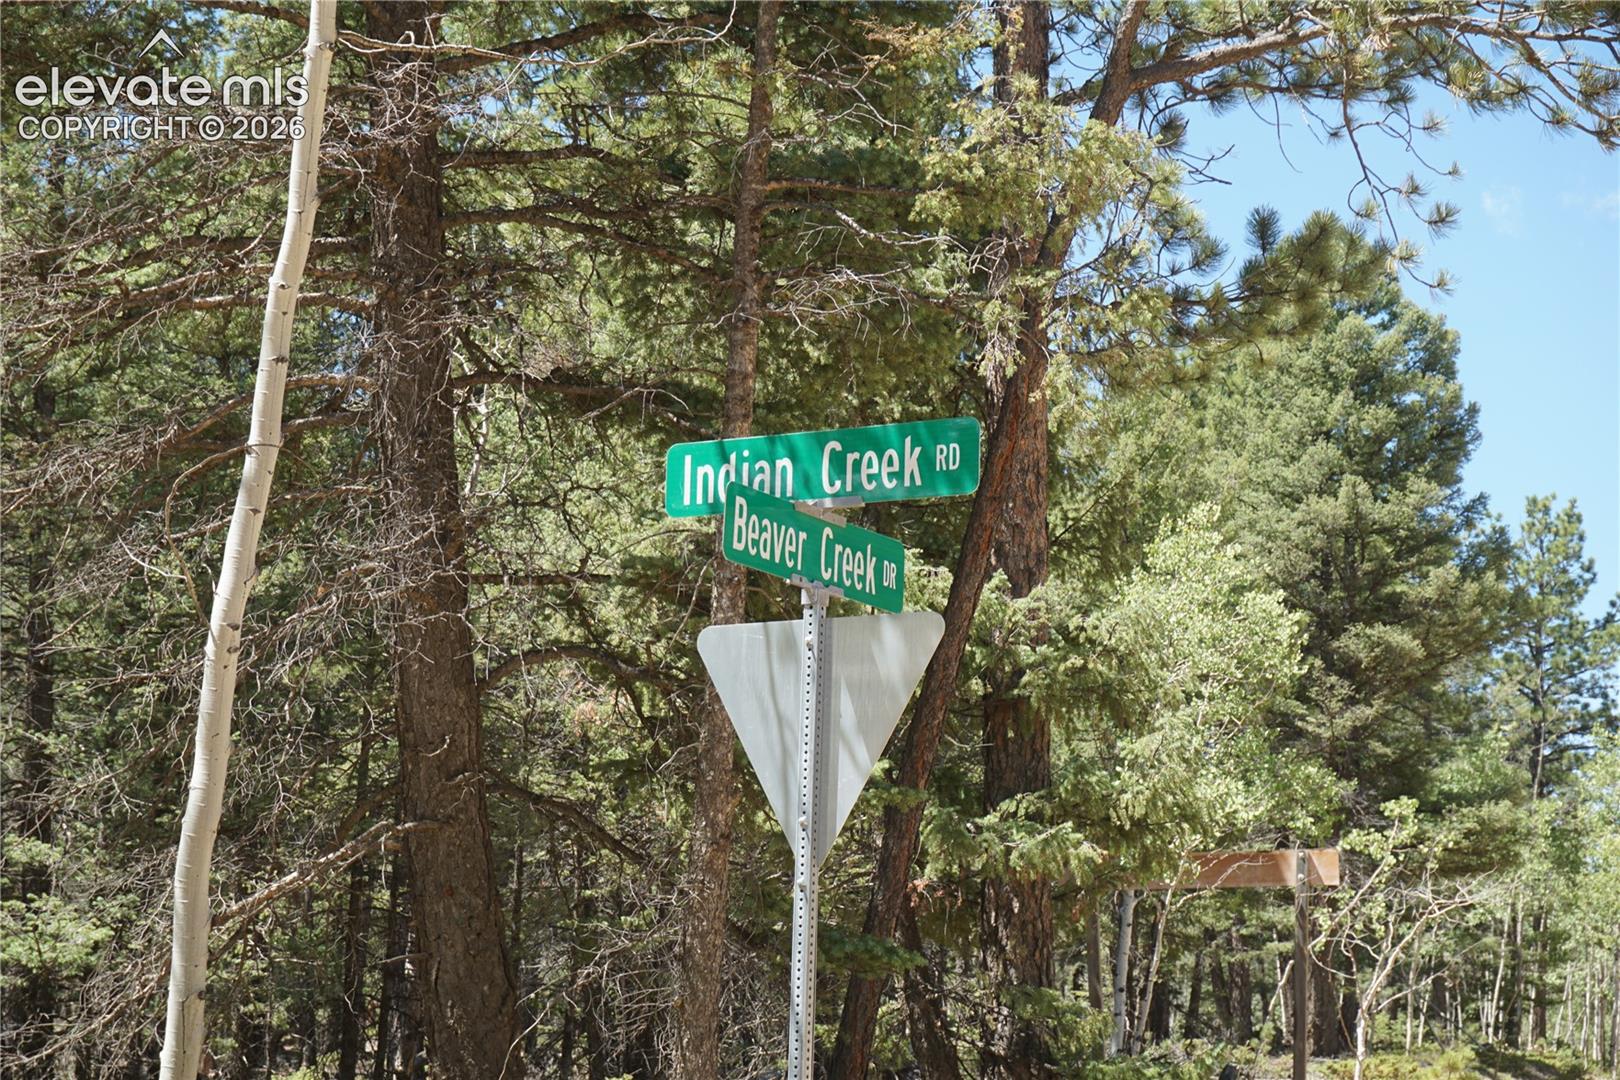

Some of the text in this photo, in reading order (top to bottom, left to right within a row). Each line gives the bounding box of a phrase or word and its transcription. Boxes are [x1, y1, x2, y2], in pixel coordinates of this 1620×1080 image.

[682, 435, 960, 505] Indian Creek RD
[732, 495, 897, 595] Beaver Creek DR
